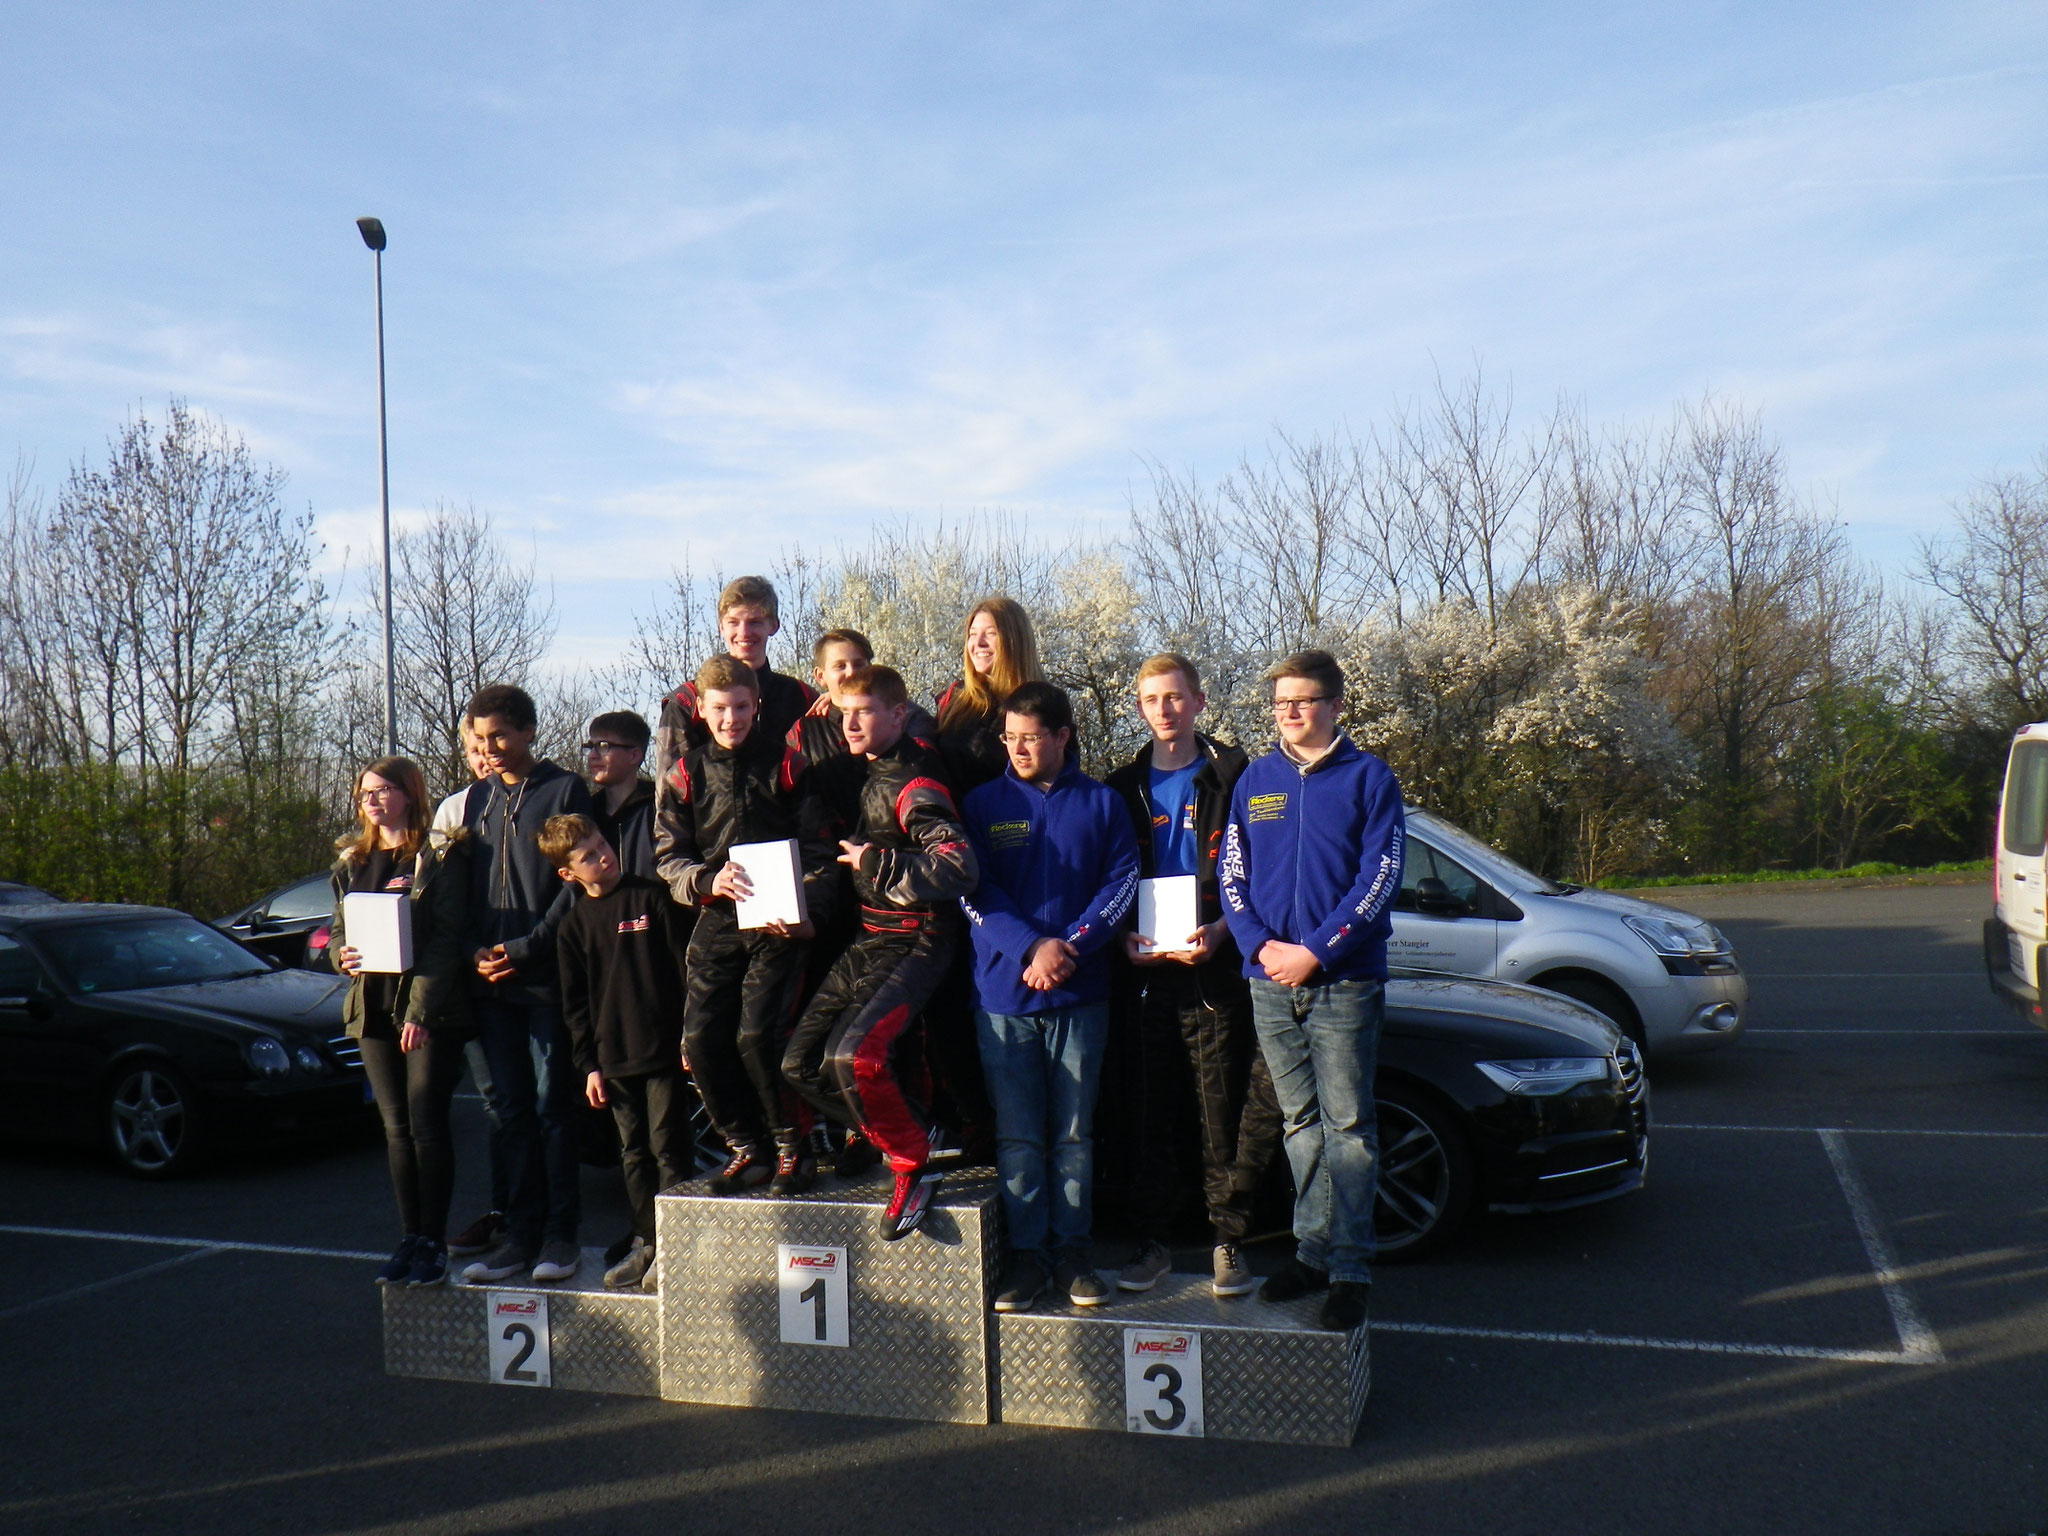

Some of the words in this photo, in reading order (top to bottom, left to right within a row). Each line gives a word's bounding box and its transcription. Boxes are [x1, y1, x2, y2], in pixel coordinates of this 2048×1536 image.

[1100, 866, 1138, 917] Automobile
[1108, 879, 1139, 927] ermann
[1225, 886, 1244, 912] KFZ
[1355, 854, 1391, 915] Automobile
[1365, 824, 1402, 923] Zimmermann
[1400, 939, 1429, 949] Stangier
[800, 1278, 827, 1341] 1
[502, 1322, 538, 1382] 2
[1143, 1363, 1186, 1430] 3
